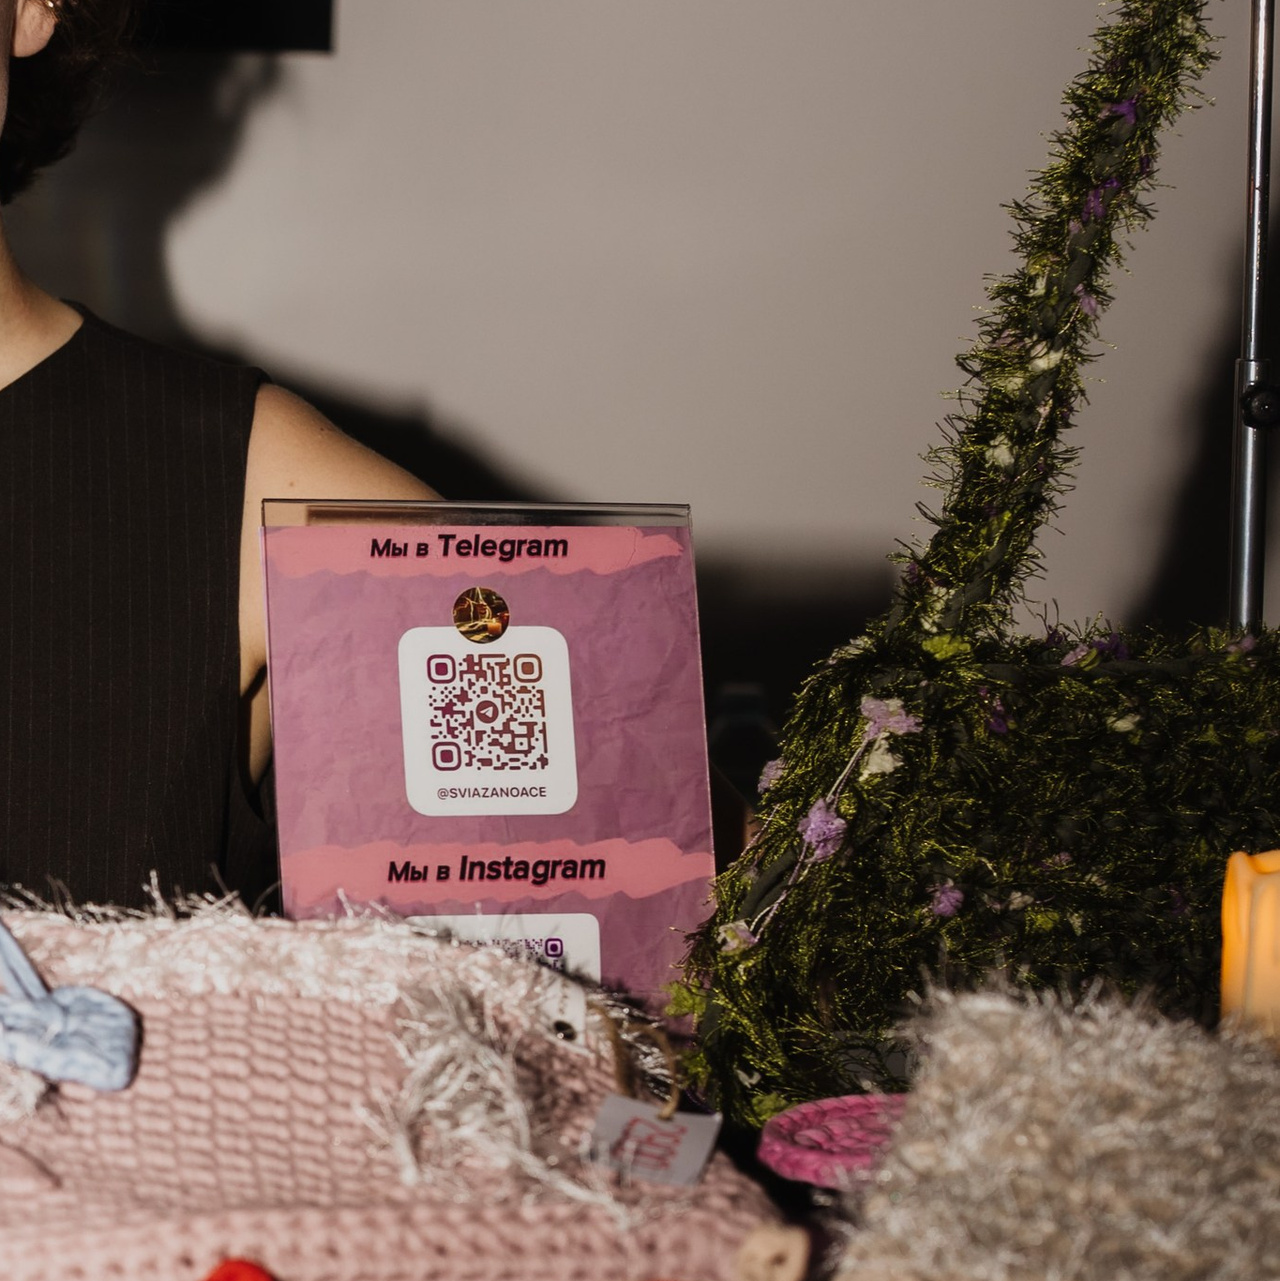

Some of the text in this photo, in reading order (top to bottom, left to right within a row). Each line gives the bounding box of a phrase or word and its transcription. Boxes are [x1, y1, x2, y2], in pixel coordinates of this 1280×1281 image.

[370, 534, 568, 562] Мы в Telegram
[437, 786, 547, 800] @SVIAZANOACE
[388, 855, 606, 885] Мы в Instagram
